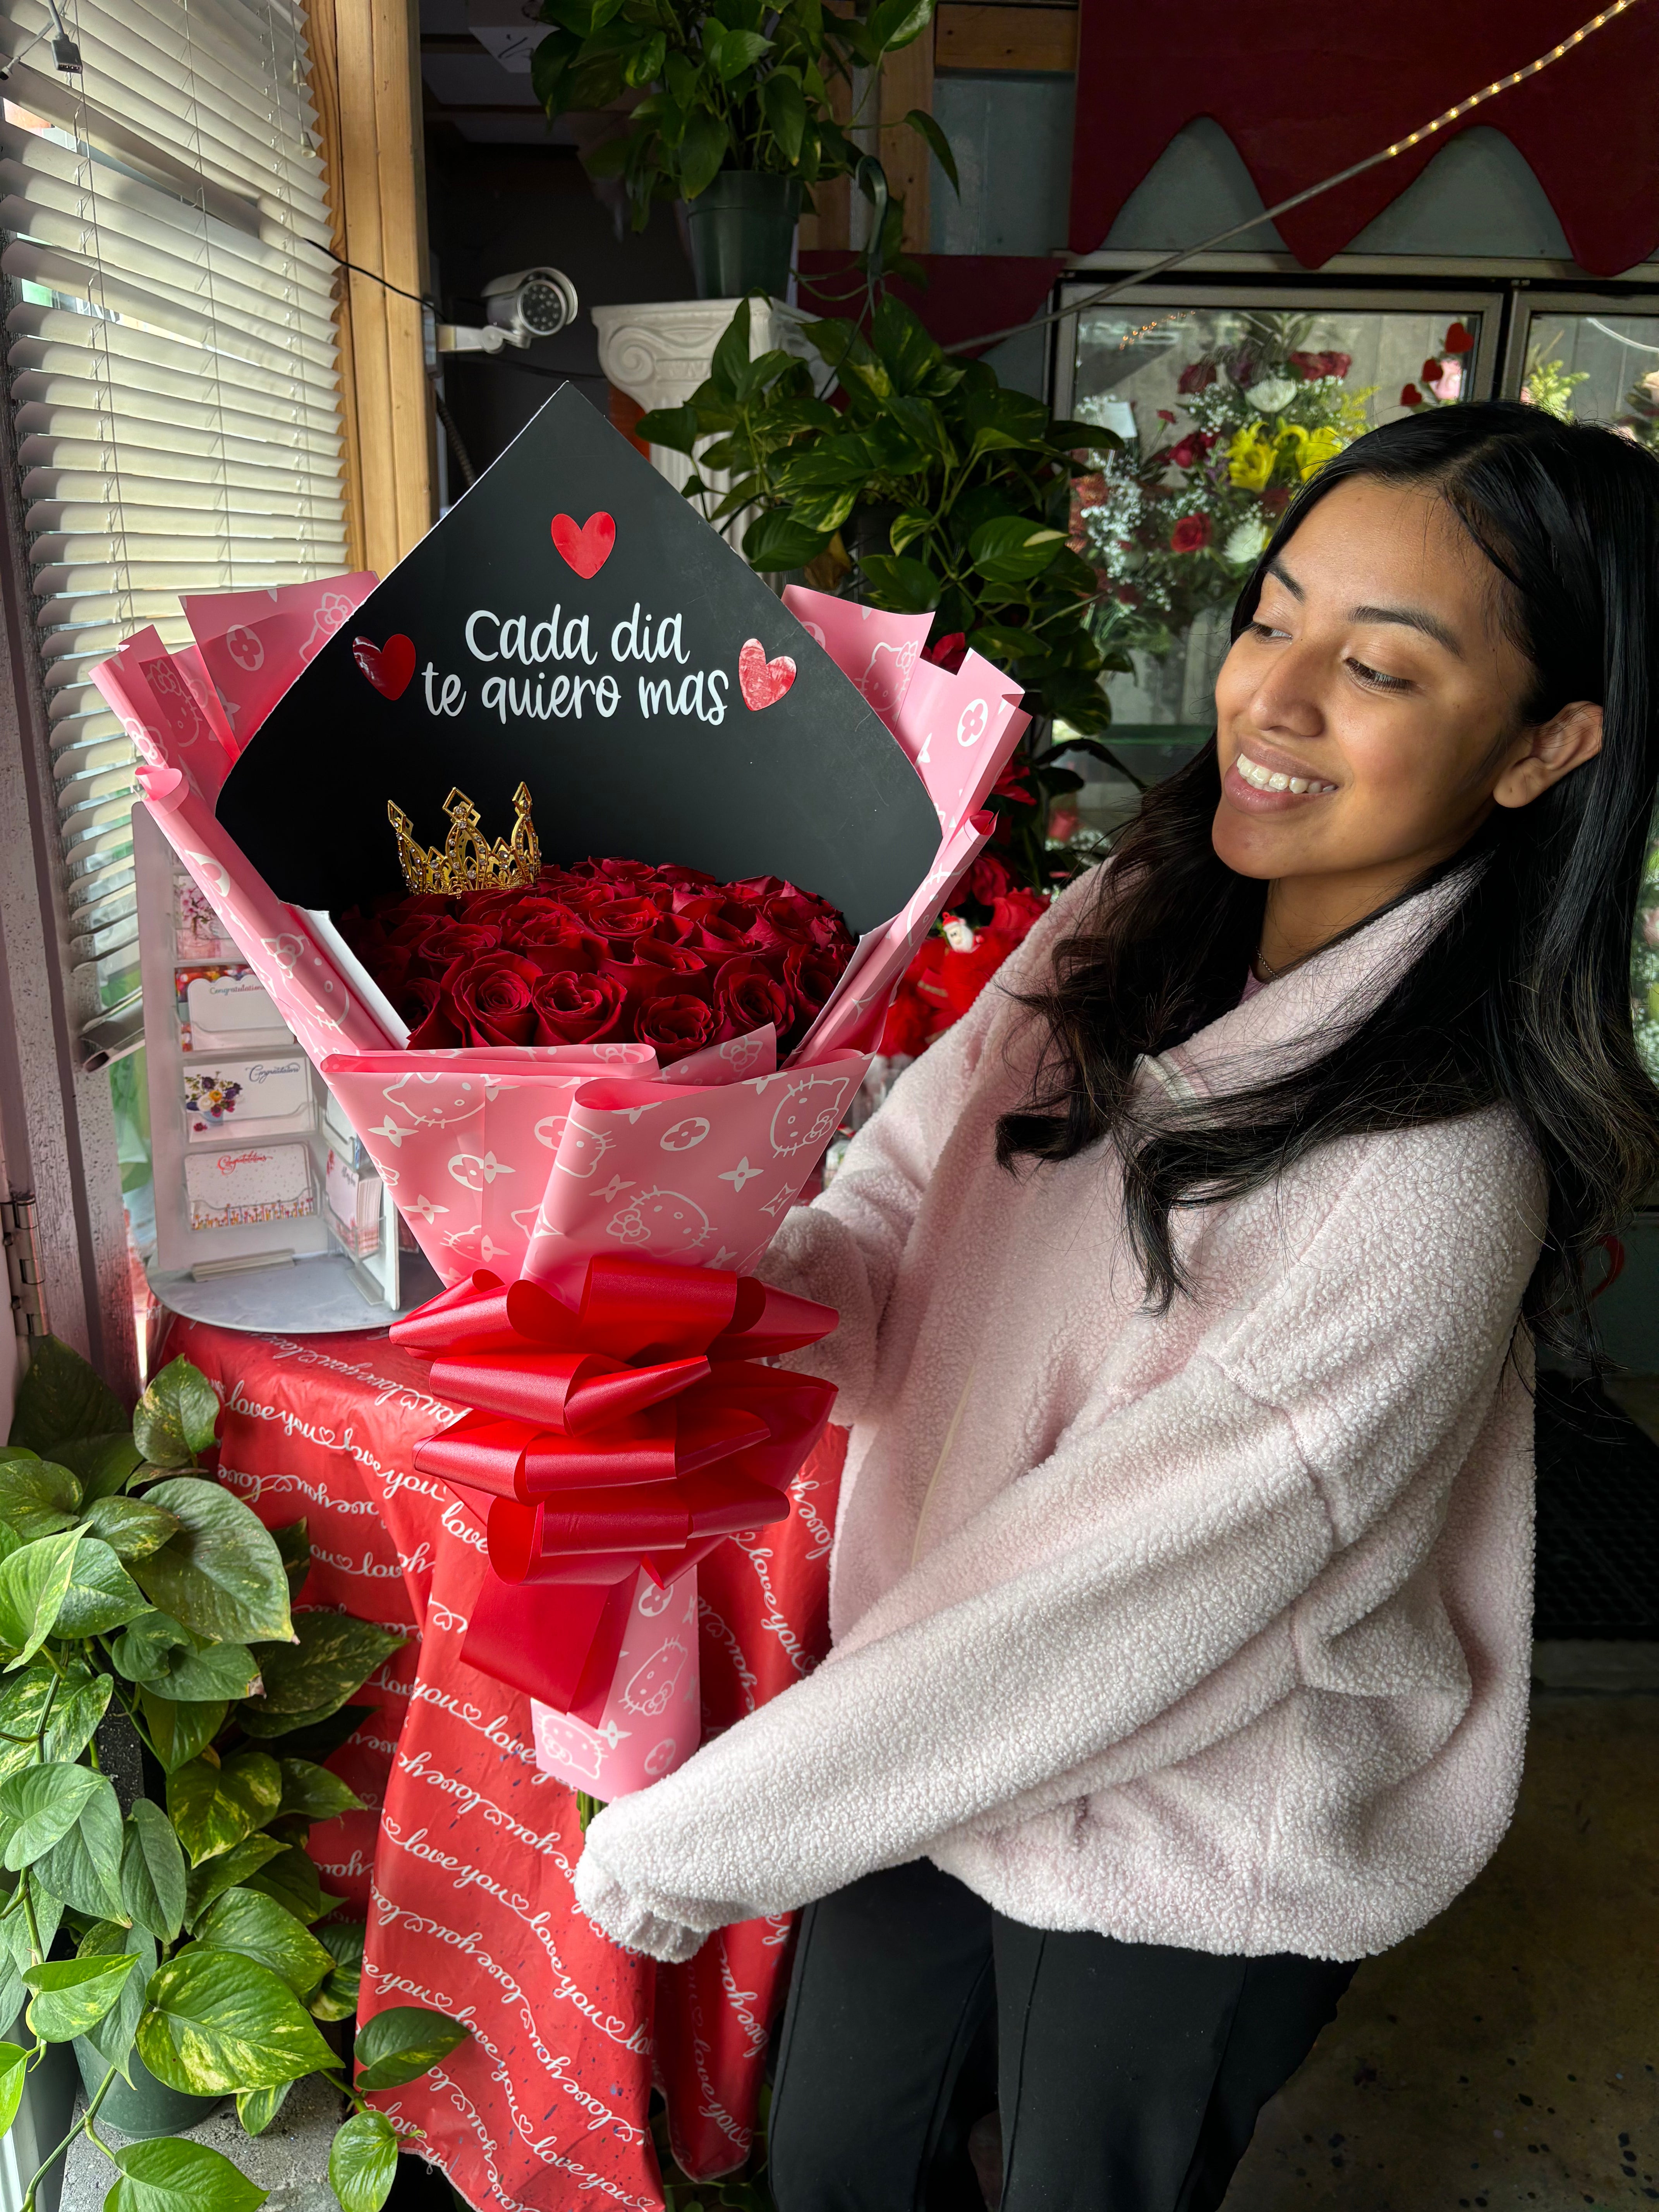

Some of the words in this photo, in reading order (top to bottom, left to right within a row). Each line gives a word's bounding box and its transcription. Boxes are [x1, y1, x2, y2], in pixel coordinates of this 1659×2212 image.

[465, 603, 598, 665] Cada
[611, 602, 690, 664] dia
[422, 661, 467, 717] te
[481, 672, 622, 724] quiero
[639, 669, 729, 726] mas
